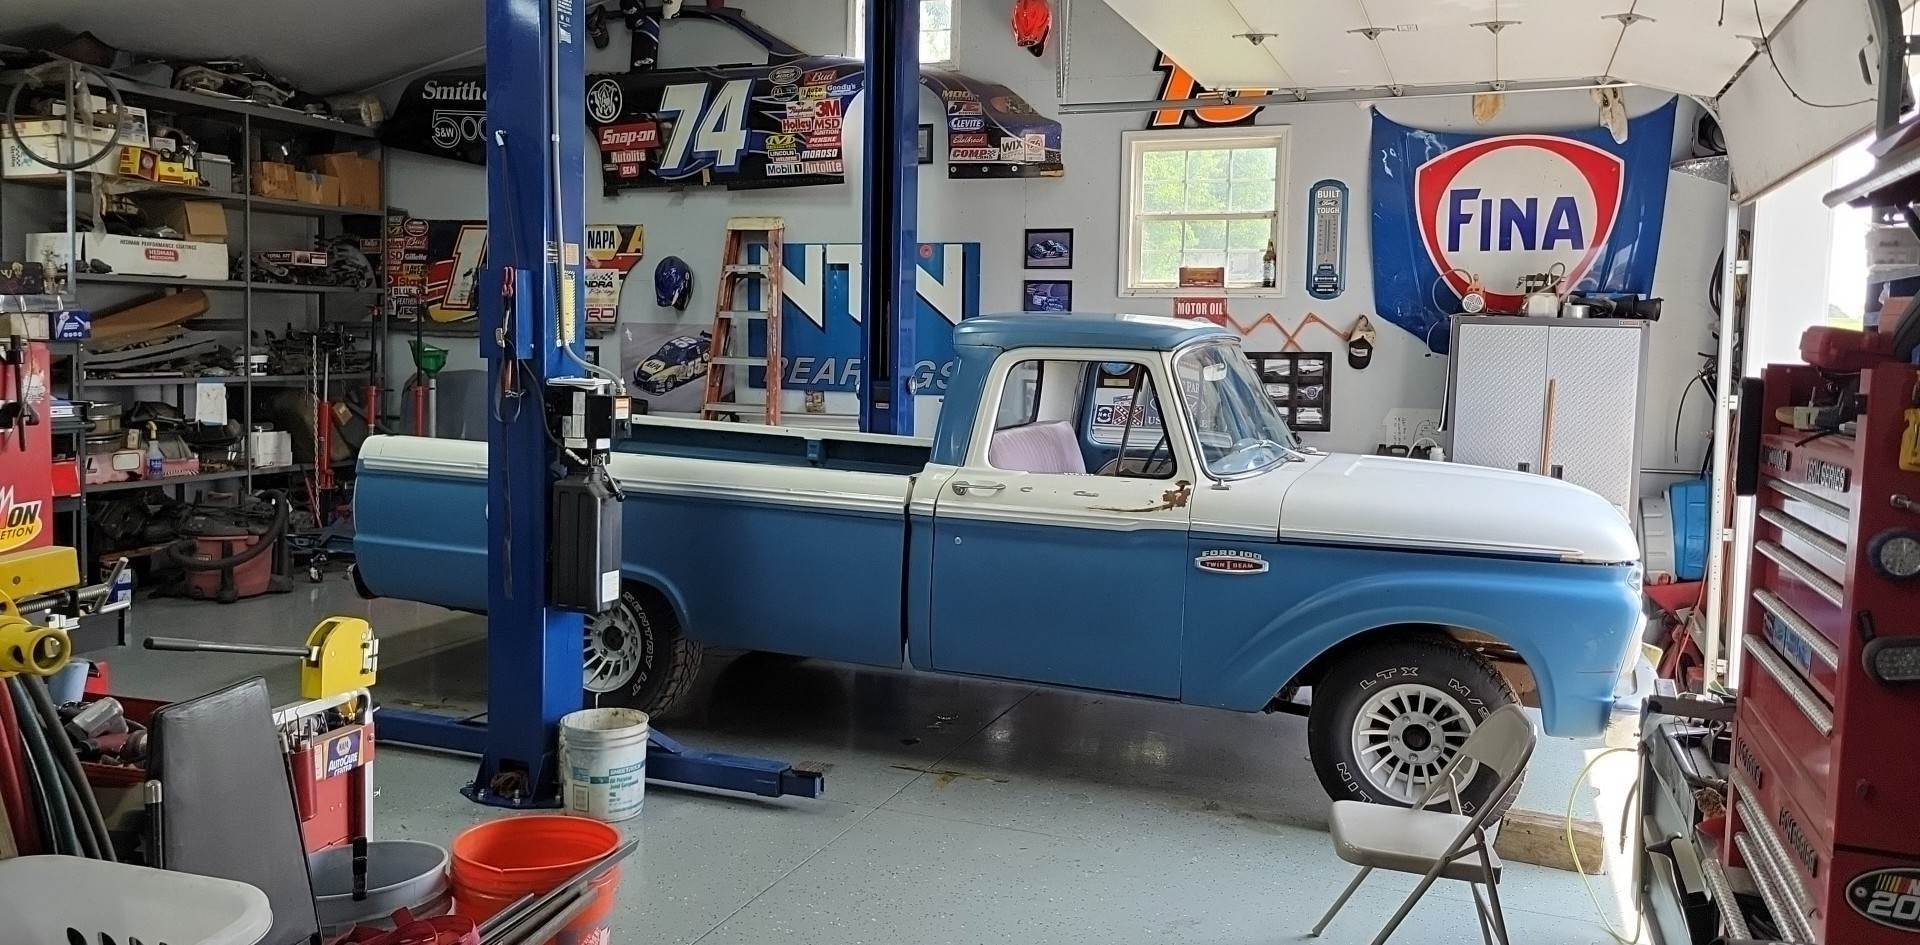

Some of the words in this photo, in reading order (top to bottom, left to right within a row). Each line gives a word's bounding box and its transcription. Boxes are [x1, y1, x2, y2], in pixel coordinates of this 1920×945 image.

[811, 70, 837, 82] Bud
[422, 80, 481, 100] Smith
[815, 100, 841, 117] 3M
[659, 78, 754, 172] 74
[783, 119, 812, 130] Holley
[814, 119, 840, 129] MSD
[951, 117, 981, 128] CLEVITE
[434, 127, 454, 138] S&W
[602, 128, 656, 147] Snap-on
[1002, 139, 1024, 152] WIX
[610, 151, 647, 164] Autolite
[801, 149, 838, 159] MOROSO
[952, 149, 988, 158] COMP
[622, 165, 637, 175] SEM
[768, 165, 792, 175] Mobil
[805, 162, 842, 174] Autolite
[1317, 190, 1340, 198] BUILT
[1447, 188, 1584, 252] FINA
[587, 230, 615, 250] NAPA
[585, 307, 615, 322] RD
[1177, 302, 1208, 315] MOTOR
[1209, 302, 1223, 315] OIL
[1202, 549, 1237, 557] FORD
[1240, 550, 1262, 560] 100
[1360, 666, 1419, 690] LTX
